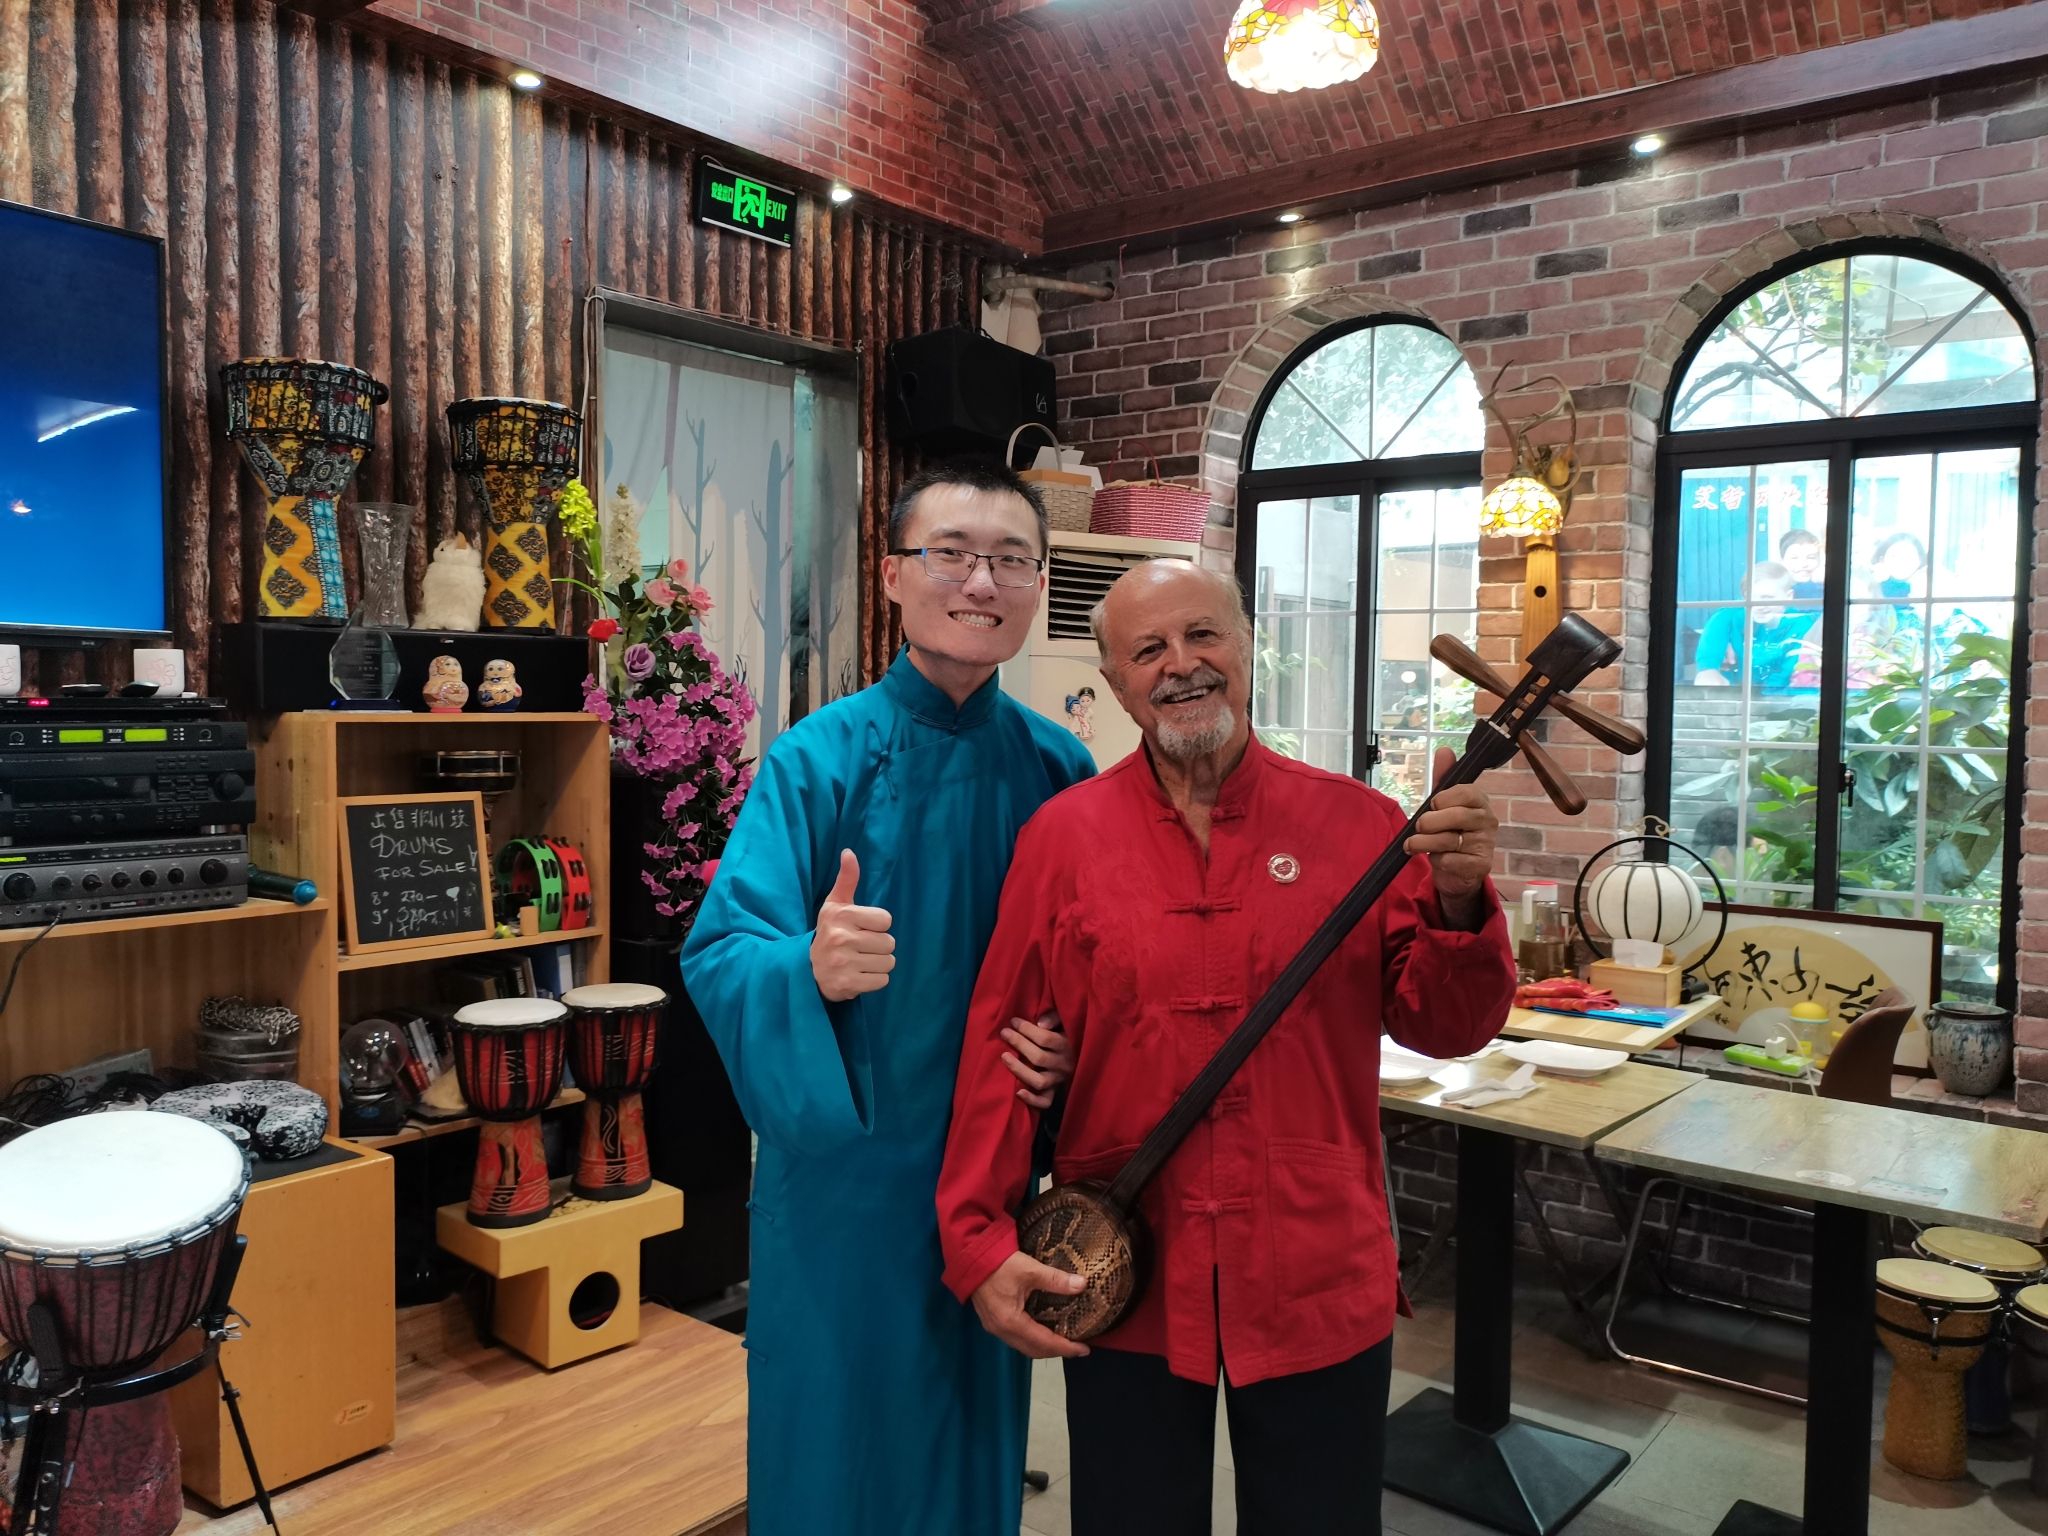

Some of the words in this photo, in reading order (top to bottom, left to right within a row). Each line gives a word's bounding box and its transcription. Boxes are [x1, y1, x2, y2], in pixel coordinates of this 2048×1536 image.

[766, 199, 787, 221] EXIT
[369, 832, 454, 858] DRUMS
[374, 866, 415, 880] FOR
